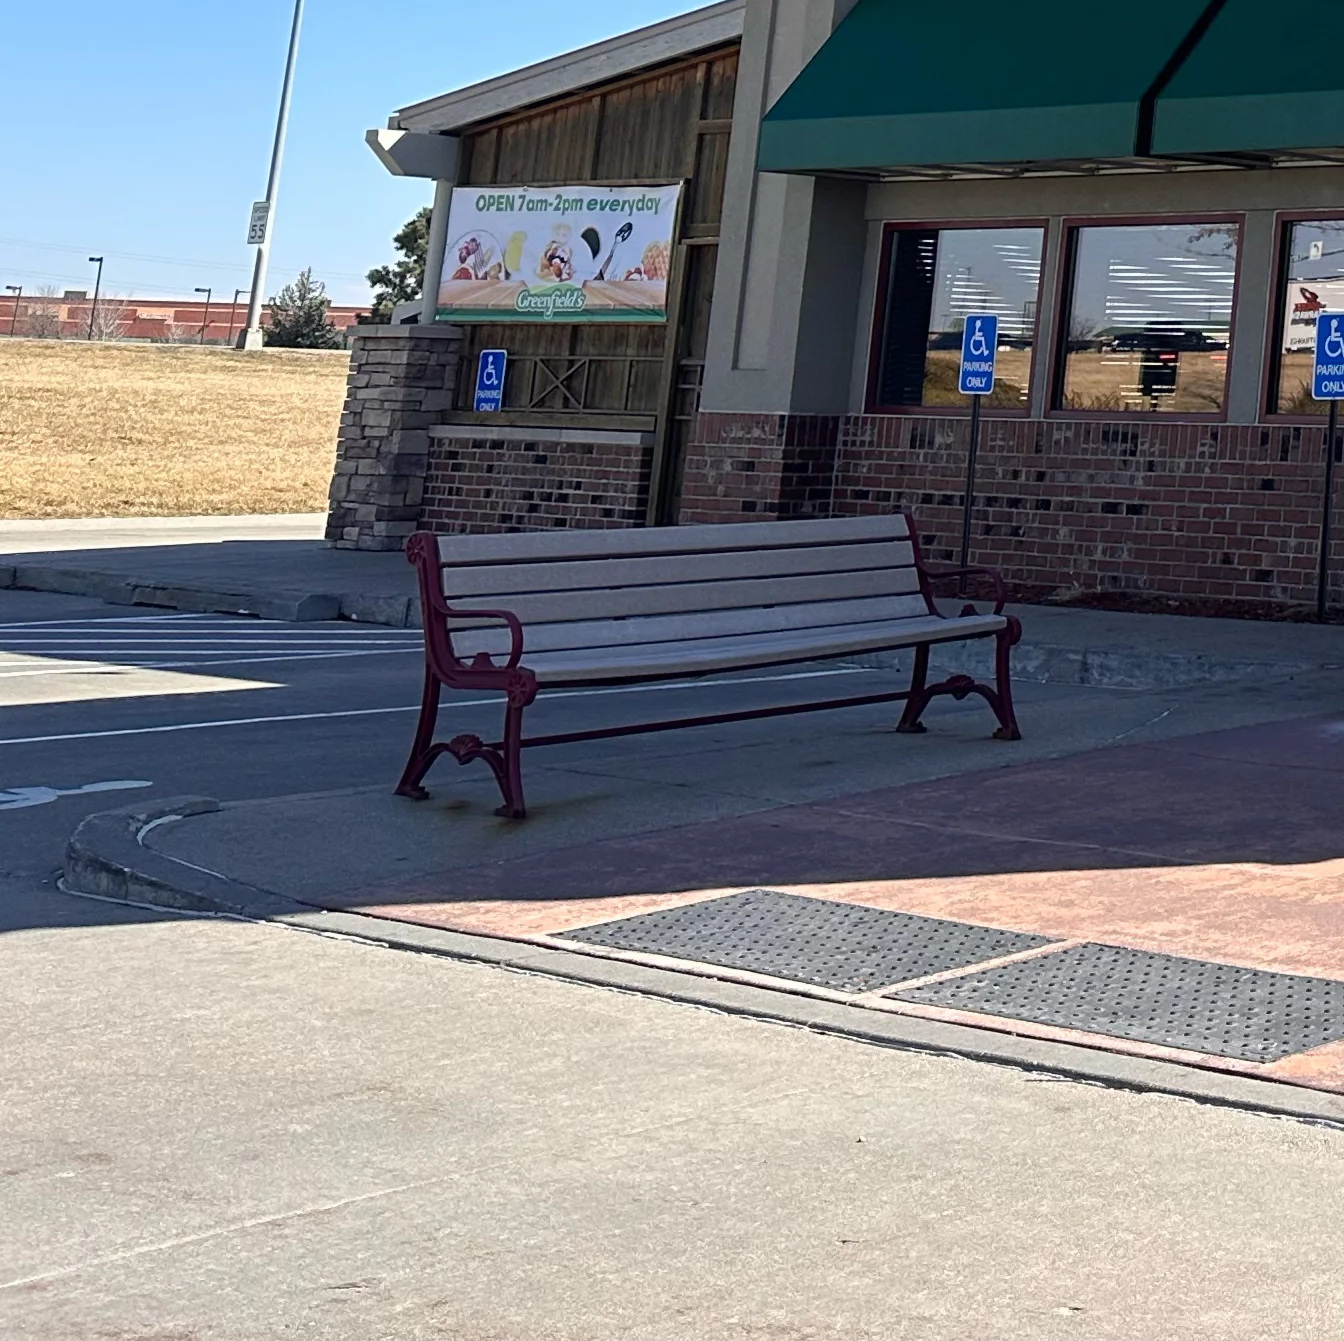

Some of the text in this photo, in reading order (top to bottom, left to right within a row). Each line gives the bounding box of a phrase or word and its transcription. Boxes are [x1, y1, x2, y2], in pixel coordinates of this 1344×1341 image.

[475, 194, 662, 216] OPEN 7am-2pm everyday
[250, 223, 265, 240] 55
[517, 287, 585, 319] Greenfield's
[963, 361, 993, 372] PARKING
[966, 376, 988, 388] ONLY
